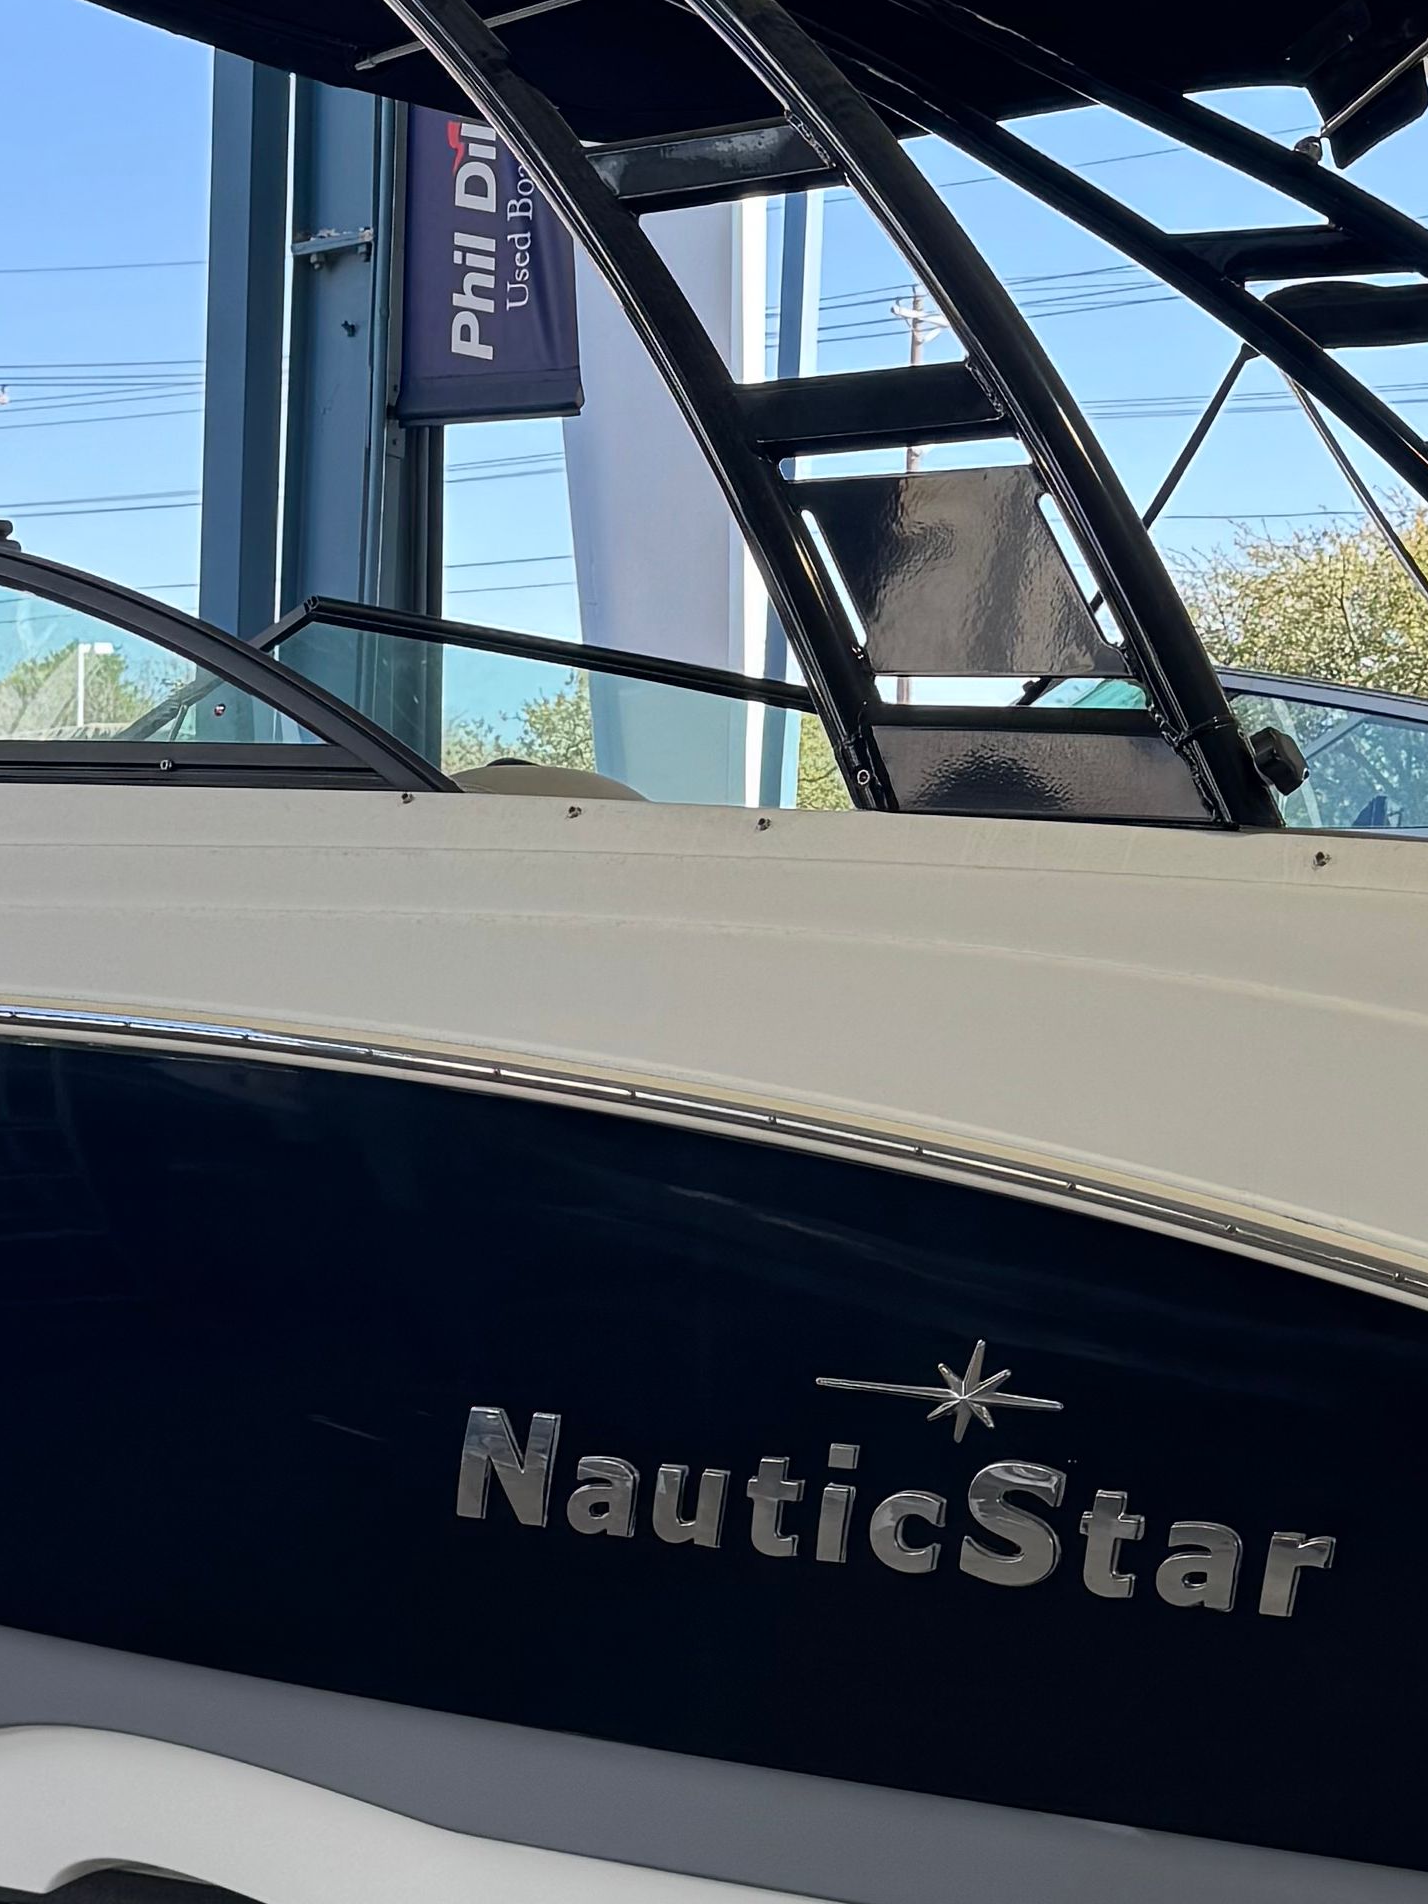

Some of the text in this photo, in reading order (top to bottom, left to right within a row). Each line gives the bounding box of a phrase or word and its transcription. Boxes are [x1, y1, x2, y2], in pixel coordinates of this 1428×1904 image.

[451, 232, 497, 360] Phil
[506, 232, 532, 311] Used
[456, 1405, 1336, 1618] NauticStar
